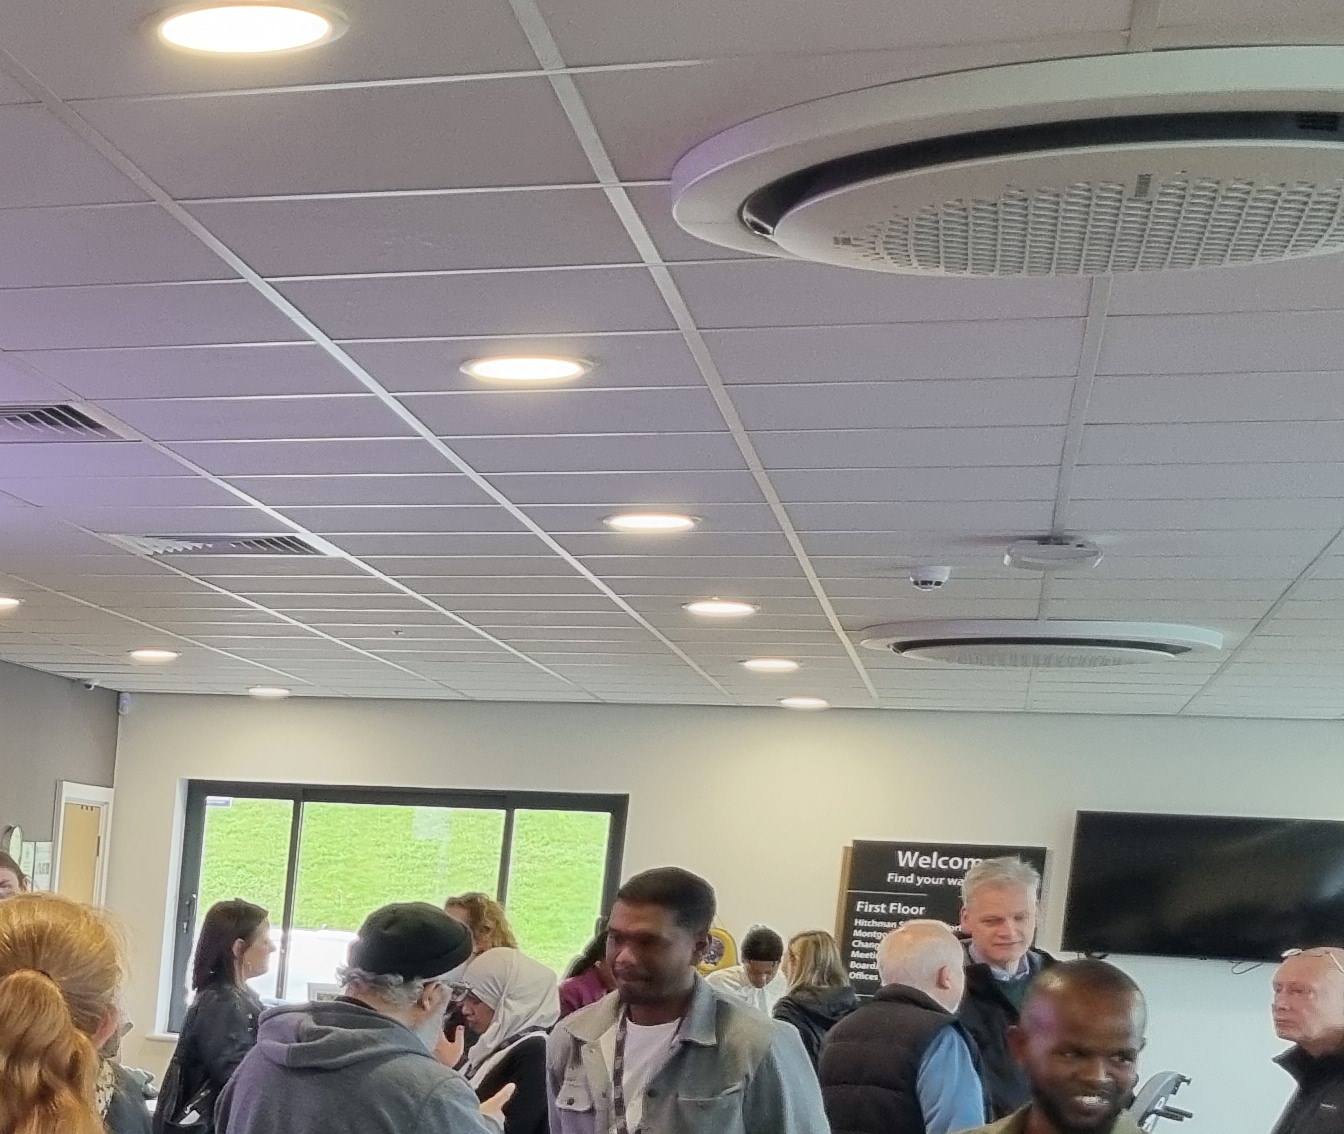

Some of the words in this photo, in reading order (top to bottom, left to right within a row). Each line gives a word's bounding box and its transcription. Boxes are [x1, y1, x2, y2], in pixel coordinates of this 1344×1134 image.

[897, 850, 983, 870] Welcom
[887, 872, 914, 884] Find
[916, 875, 945, 887] your
[947, 877, 964, 886] wa
[856, 901, 887, 913] First
[889, 902, 926, 915] Floor
[853, 930, 888, 940] Montgo
[852, 940, 880, 951] Chang
[851, 951, 877, 959] Meeti
[850, 961, 878, 970] Board
